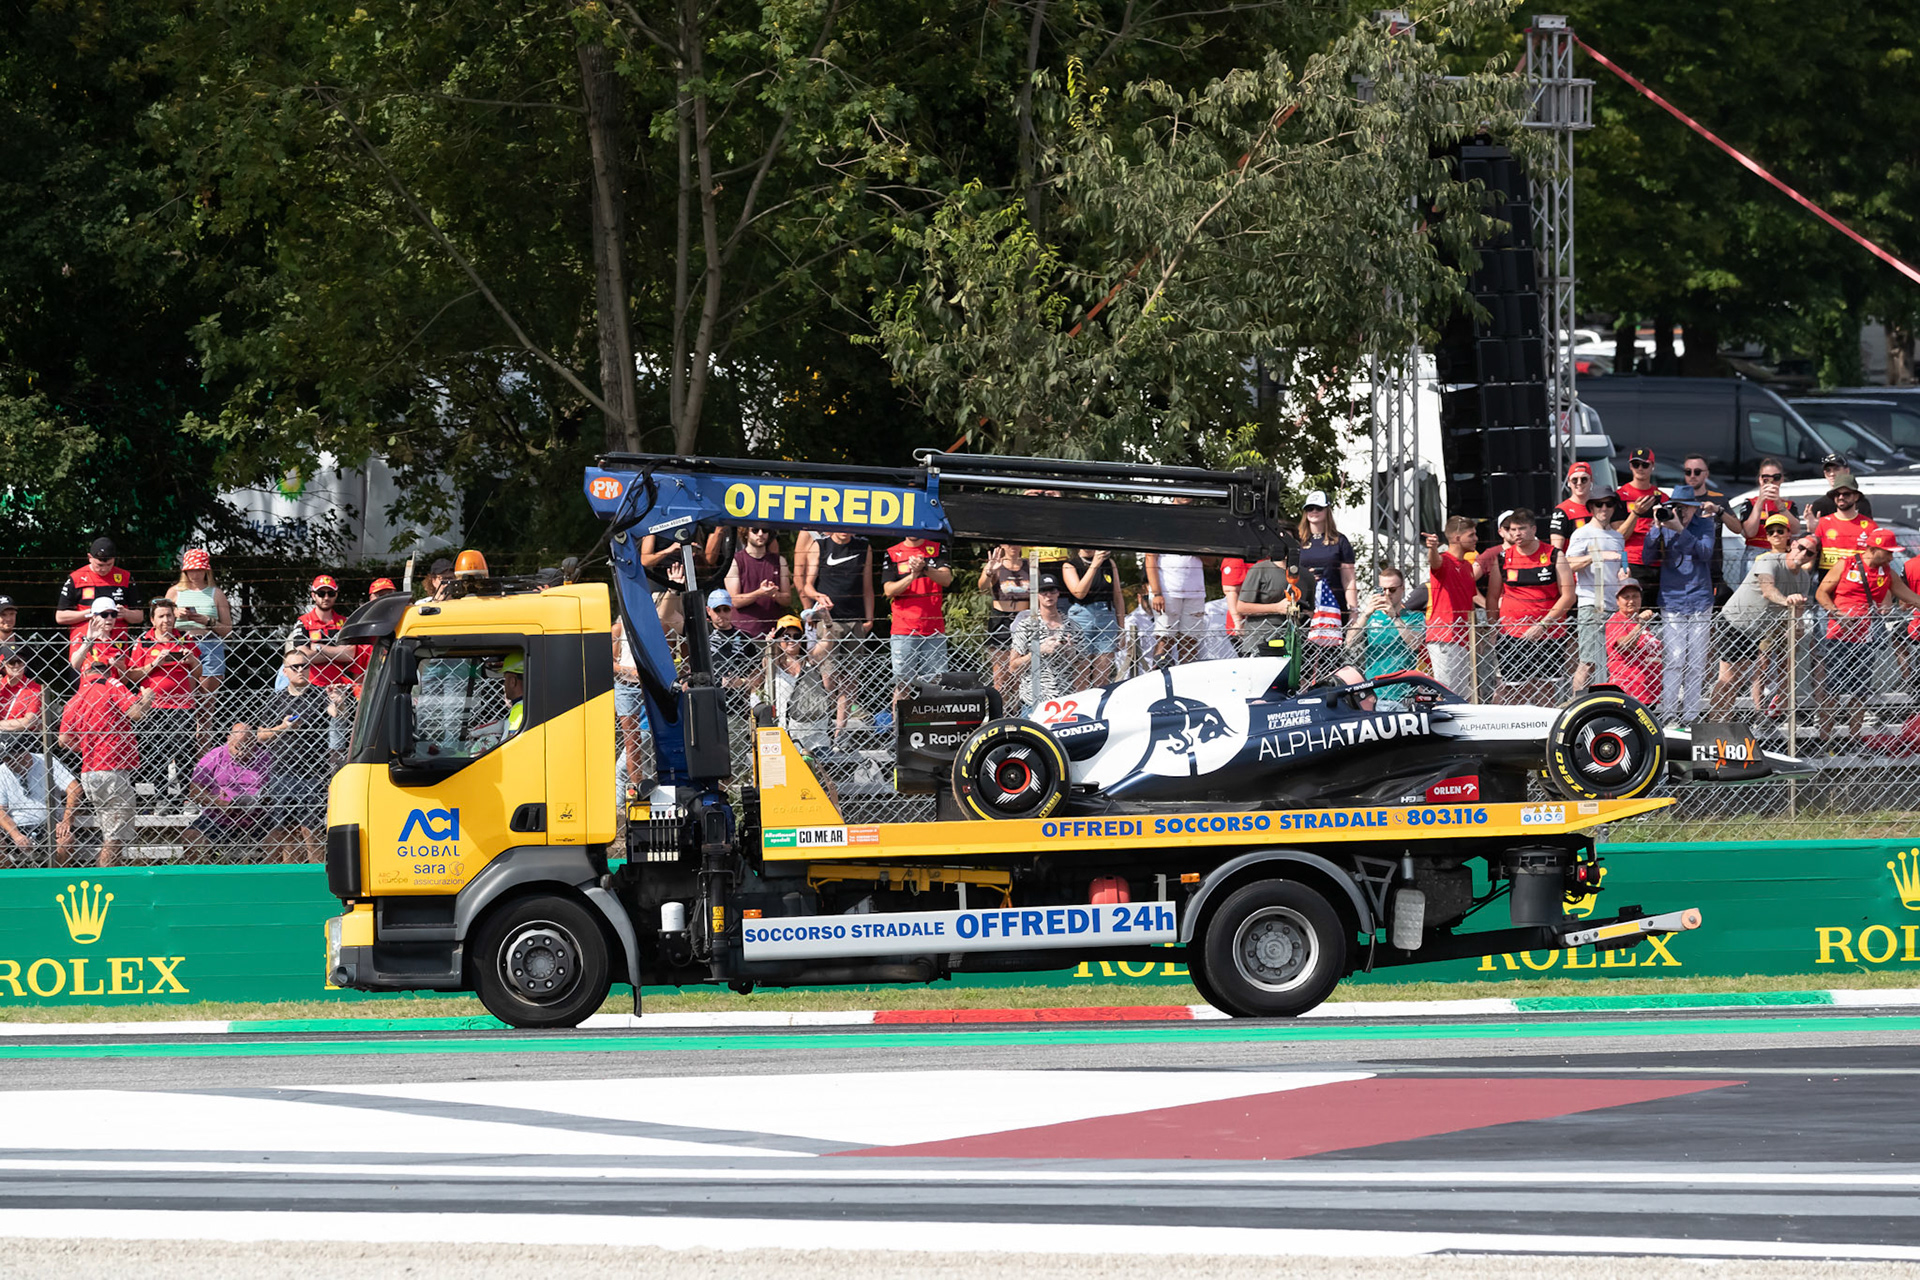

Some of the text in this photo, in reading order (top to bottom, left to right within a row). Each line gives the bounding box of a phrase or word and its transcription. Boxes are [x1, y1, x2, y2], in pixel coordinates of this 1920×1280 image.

[593, 480, 620, 498] PM
[724, 483, 915, 527] OFFREDI
[911, 703, 981, 715] ALPHATAURI
[1043, 700, 1079, 724] 22
[1267, 709, 1311, 721] WHATEVER
[964, 727, 1000, 764] ZERO
[1258, 712, 1430, 762] ALPHATAURI
[1692, 737, 1756, 771] FLEXBOX
[1555, 751, 1584, 793] ZERO
[1433, 786, 1461, 796] ORLEN
[397, 807, 460, 842] ACI
[1042, 808, 1488, 838] OFFREDI SOCCORSO STRADALE 803.116
[397, 845, 461, 857] GLOBAL
[413, 863, 446, 875] sara
[413, 877, 465, 886] assicurazioni
[744, 905, 1175, 943] SOCCORSO STRADALE OFFREDI 24h
[0, 956, 190, 997] ROLEX
